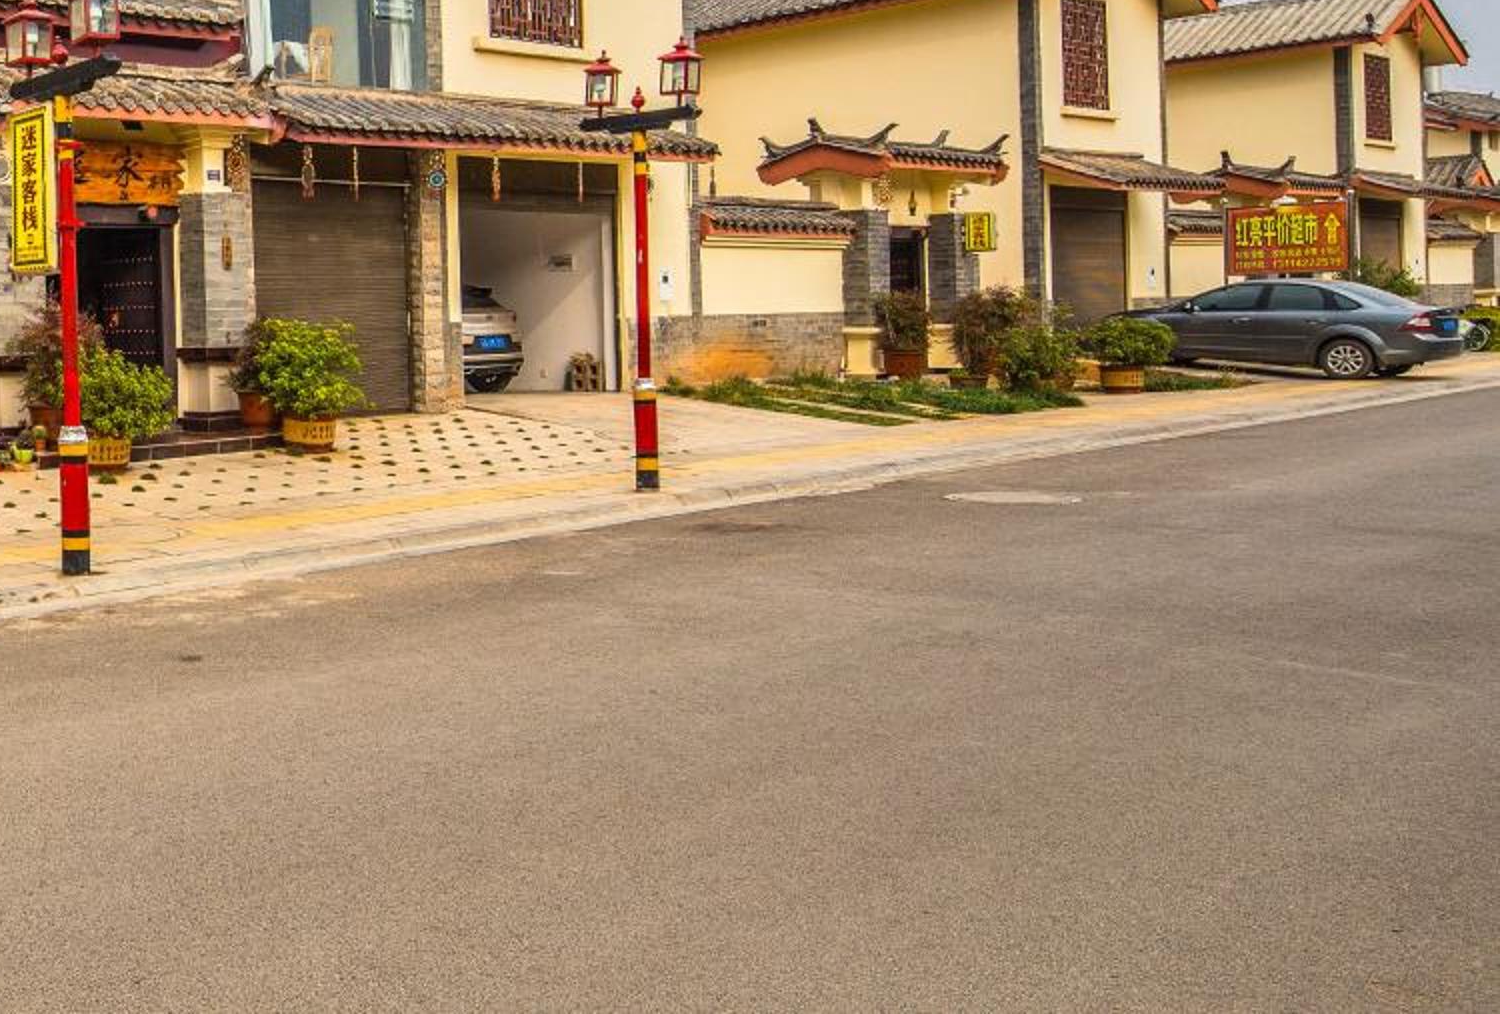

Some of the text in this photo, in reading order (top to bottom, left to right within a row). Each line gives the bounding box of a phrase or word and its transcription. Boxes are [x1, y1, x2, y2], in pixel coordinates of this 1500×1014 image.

[1235, 212, 1317, 247] 红亮平价超市
